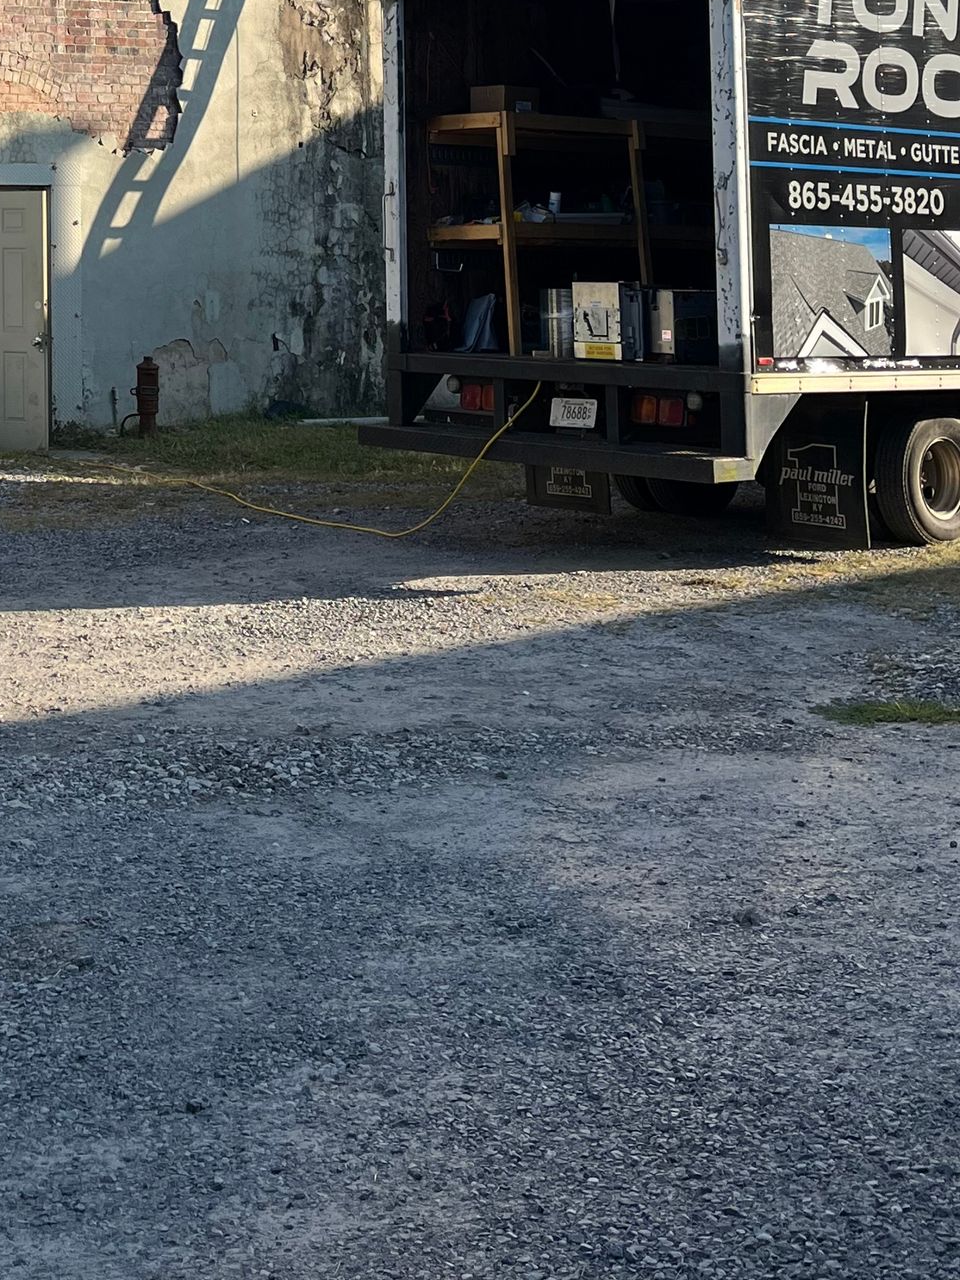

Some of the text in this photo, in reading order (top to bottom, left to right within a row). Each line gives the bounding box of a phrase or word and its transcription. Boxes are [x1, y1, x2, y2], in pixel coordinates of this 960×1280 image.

[767, 132, 960, 164] FASCIA METAL GUTTE
[788, 180, 945, 216] 865-455-3820
[779, 466, 855, 486] paul miller
[807, 482, 827, 492] FORD
